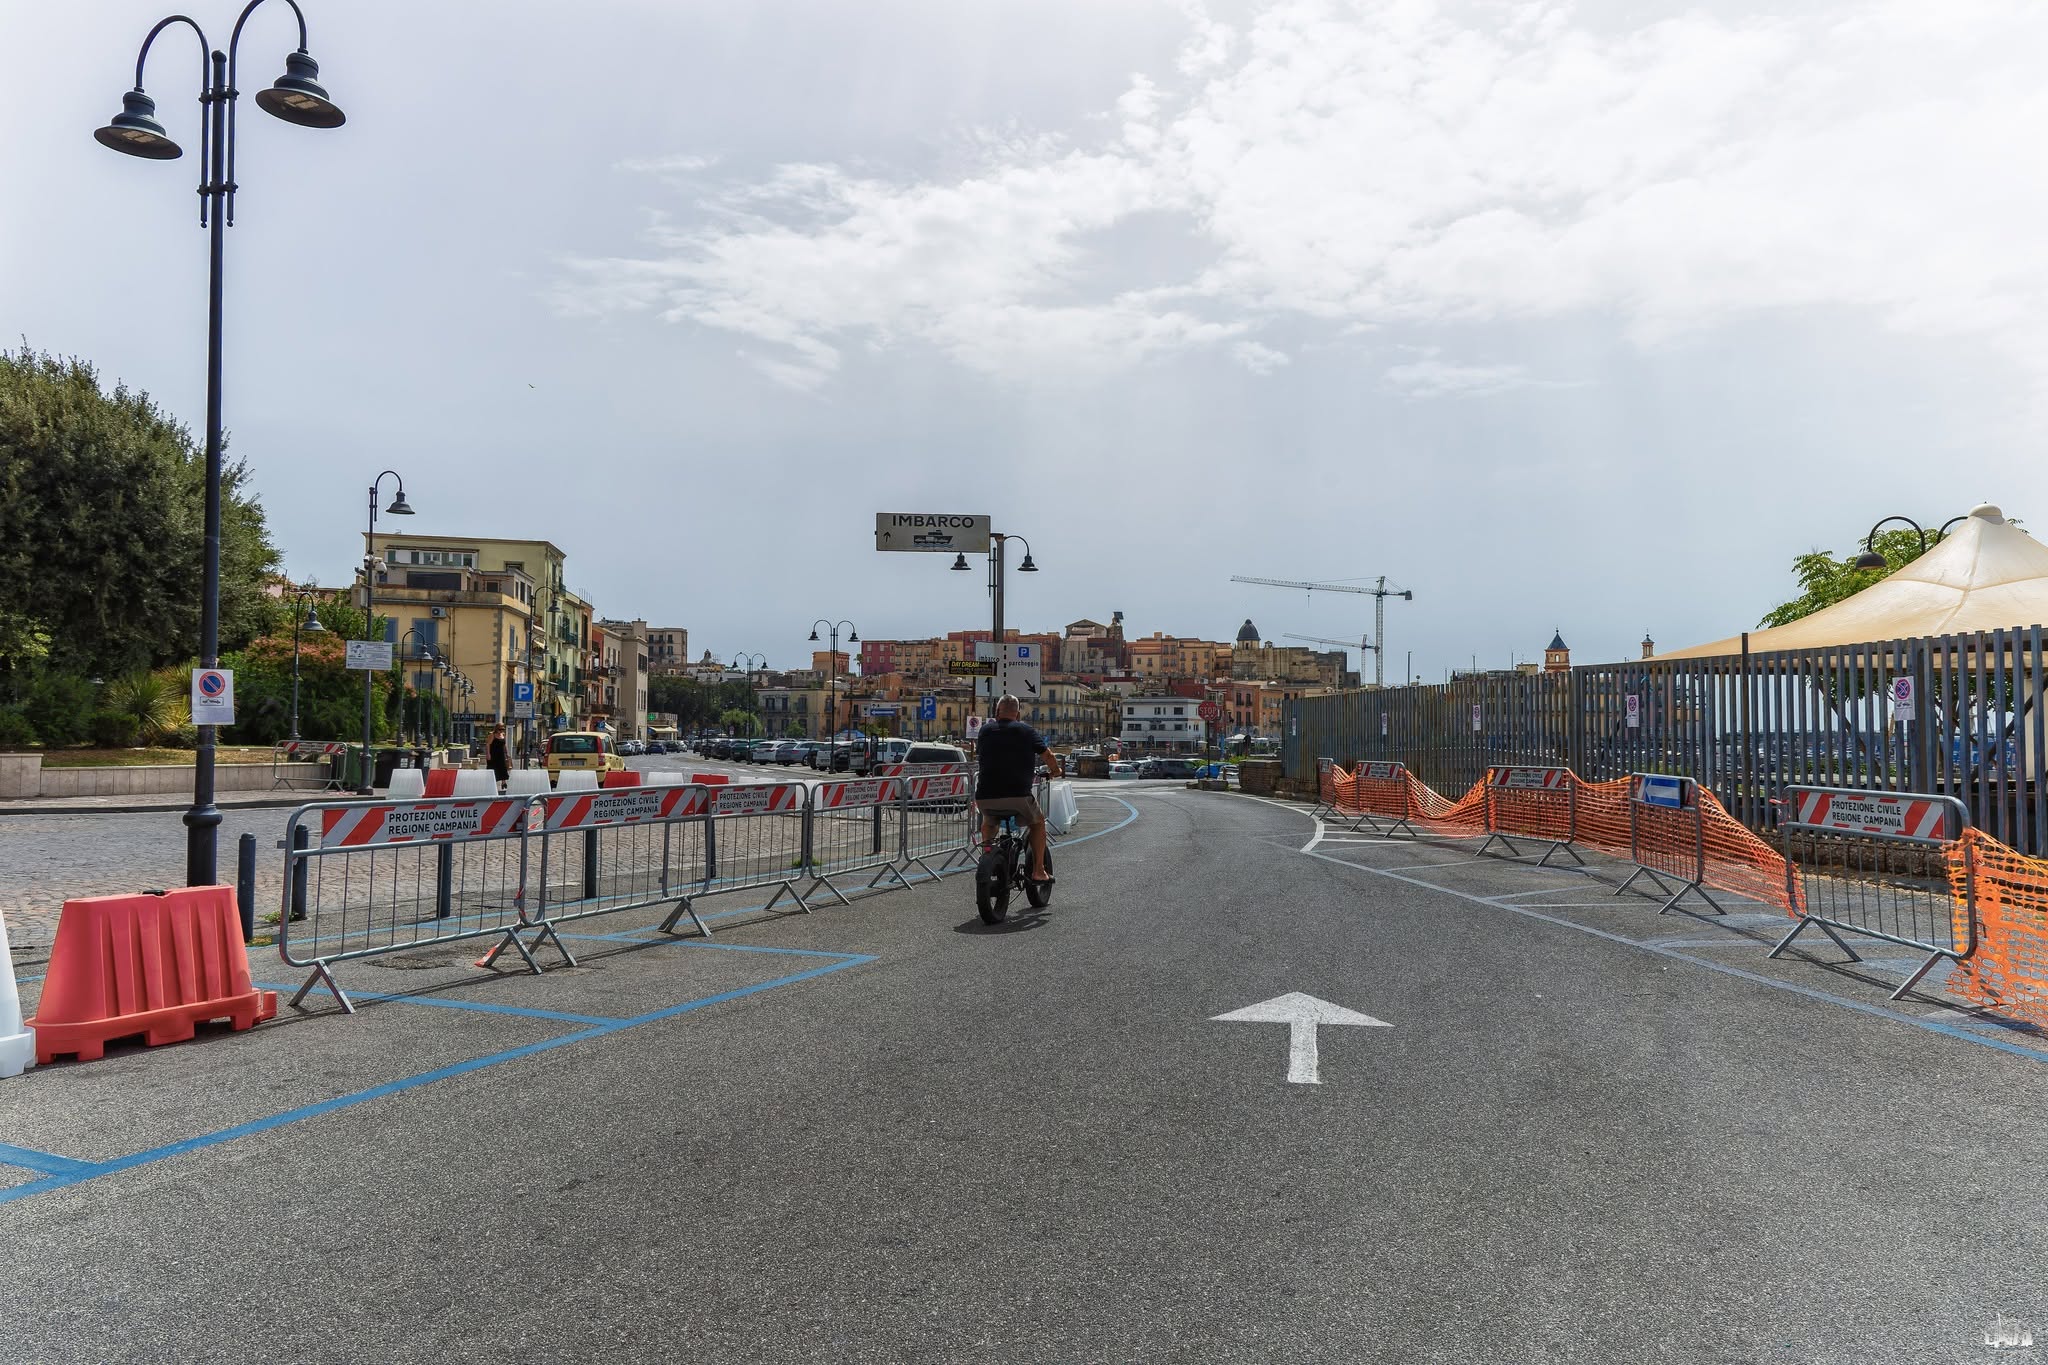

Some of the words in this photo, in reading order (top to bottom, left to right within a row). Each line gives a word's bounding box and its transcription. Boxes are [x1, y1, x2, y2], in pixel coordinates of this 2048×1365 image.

[892, 515, 974, 528] IMBARCO
[1020, 648, 1027, 656] P
[518, 685, 530, 699] P
[923, 698, 933, 710] P
[1199, 706, 1217, 715] STOP
[752, 791, 768, 799] CIVILE
[594, 797, 637, 808] PROTEZIONE
[638, 796, 659, 805] CIVILE
[720, 801, 742, 809] REGIONE
[743, 799, 768, 807] CAMPANIA
[1831, 800, 1875, 813] PROTEZIONE
[1877, 805, 1902, 816] CIVILE
[388, 810, 447, 823] PROTEZIONE
[450, 809, 478, 819] CIVILE
[593, 808, 625, 818] REGIONE
[626, 806, 659, 815] CAMPANIA
[1832, 812, 1861, 823] REGIONE
[1863, 816, 1903, 828] CAMPANIA
[388, 822, 430, 834] REGIONE
[433, 821, 478, 831] CAMPANIA
